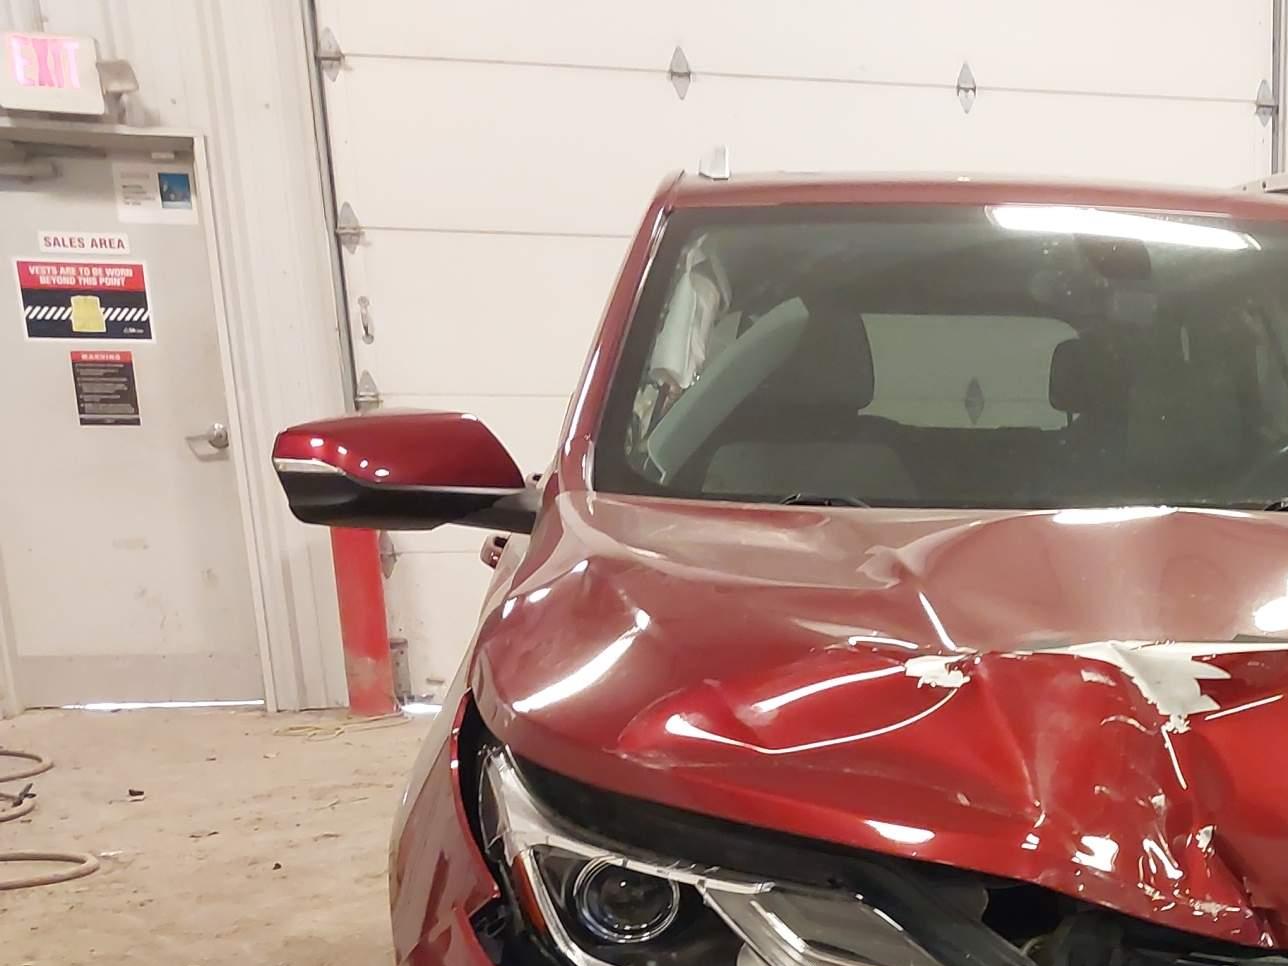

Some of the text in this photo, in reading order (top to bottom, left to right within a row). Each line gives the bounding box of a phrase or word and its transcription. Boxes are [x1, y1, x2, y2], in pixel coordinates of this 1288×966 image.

[12, 36, 80, 88] EXIT
[43, 236, 126, 250] SALES AREA
[28, 265, 133, 278] VESTS ARE TO BE WORN
[39, 275, 126, 287] BEYOND THIS POINT
[80, 353, 121, 361] WARNING
